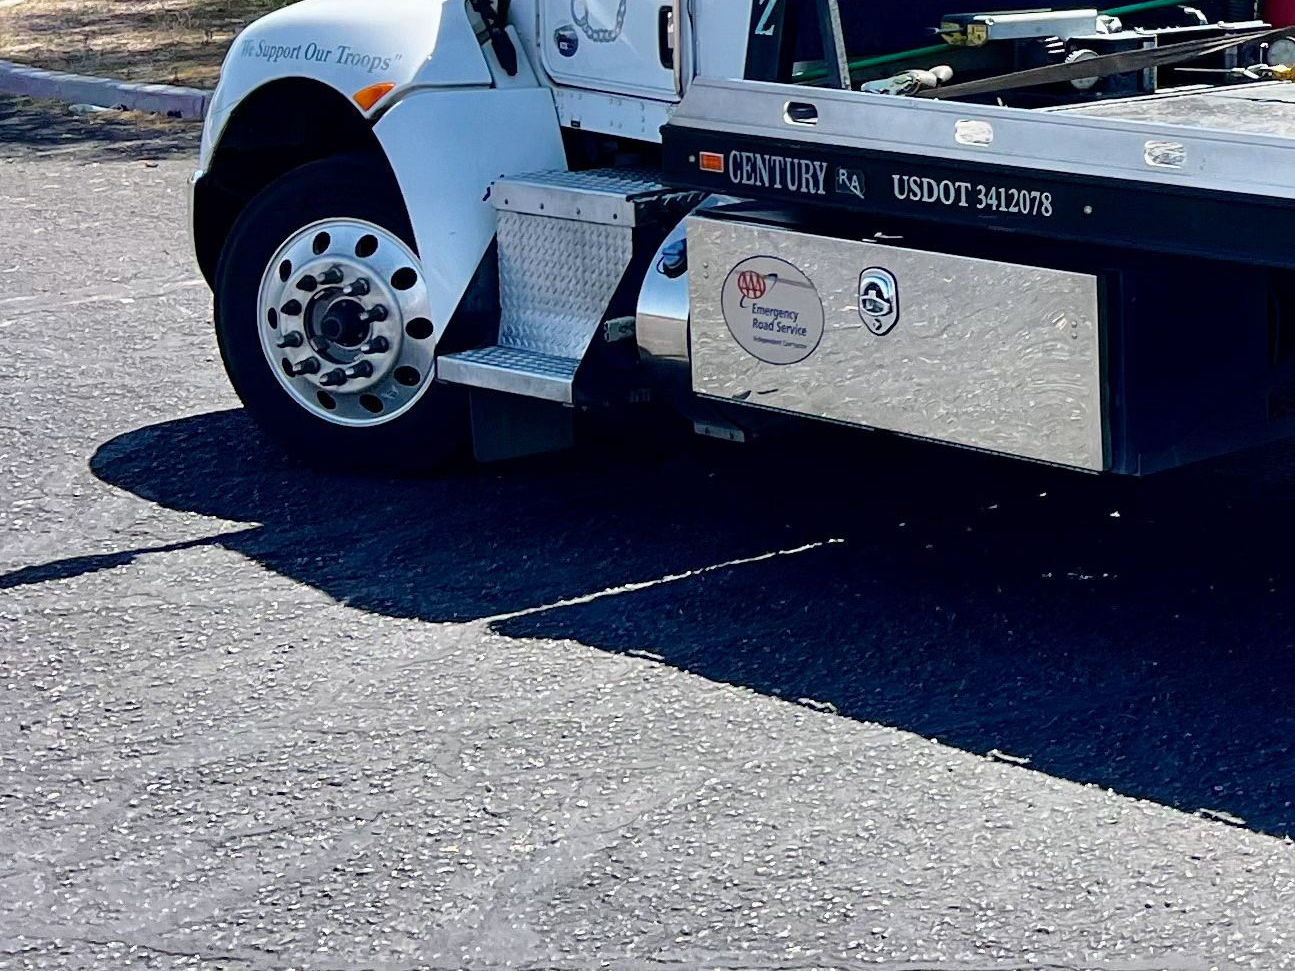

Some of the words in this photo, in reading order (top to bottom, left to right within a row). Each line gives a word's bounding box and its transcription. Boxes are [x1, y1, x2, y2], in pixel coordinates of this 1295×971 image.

[255, 39, 302, 62] Support
[304, 42, 333, 63] Our
[729, 150, 828, 195] CENTURY
[891, 174, 972, 207] USDOT
[976, 184, 1053, 217] 3412078
[738, 270, 766, 299] AAA
[752, 303, 799, 322] Emergency
[752, 318, 775, 332] Road
[776, 321, 808, 337] Service
